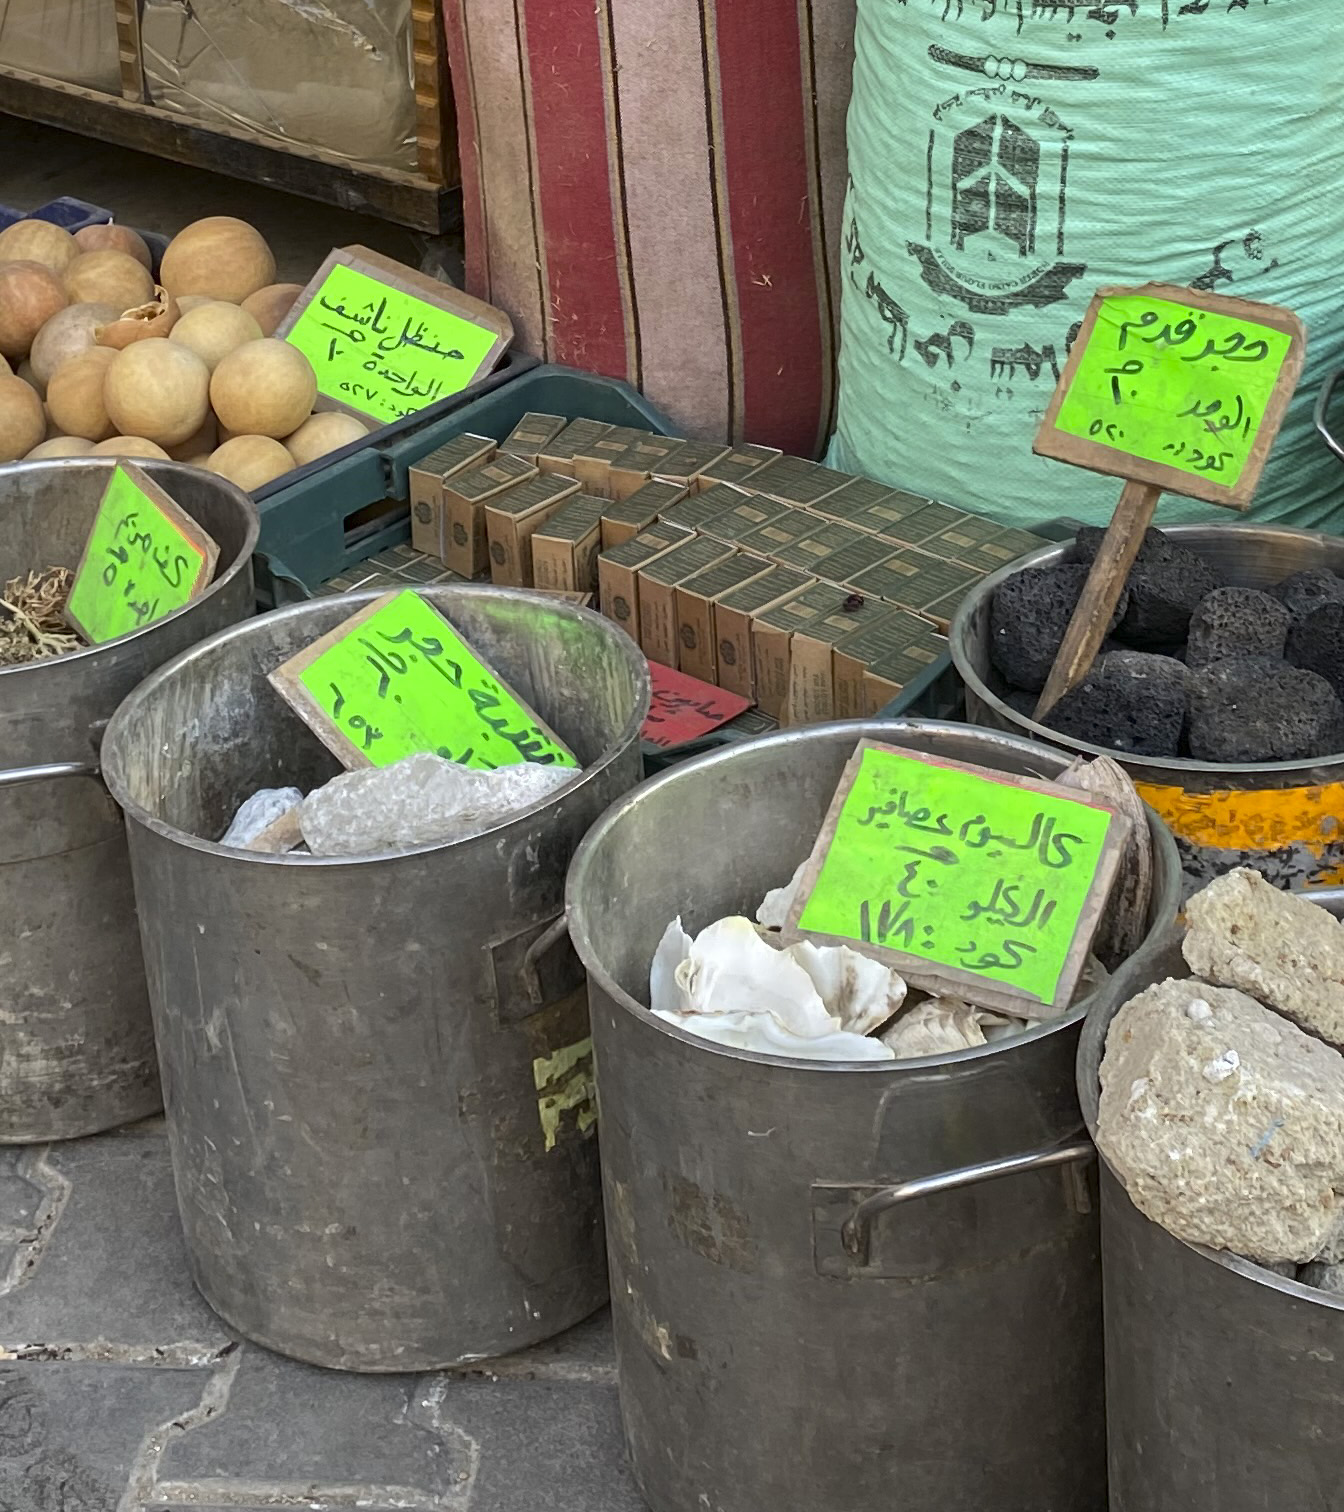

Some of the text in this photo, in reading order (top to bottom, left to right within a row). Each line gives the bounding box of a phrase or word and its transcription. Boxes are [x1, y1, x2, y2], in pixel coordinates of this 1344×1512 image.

[319, 294, 392, 335] ناشف
[1120, 310, 1270, 373] حجر قدم
[362, 351, 445, 402] الواحدة
[375, 627, 464, 690] حجر
[856, 786, 1092, 869] كالسيوم عصافير
[959, 876, 1057, 931] الكيلو
